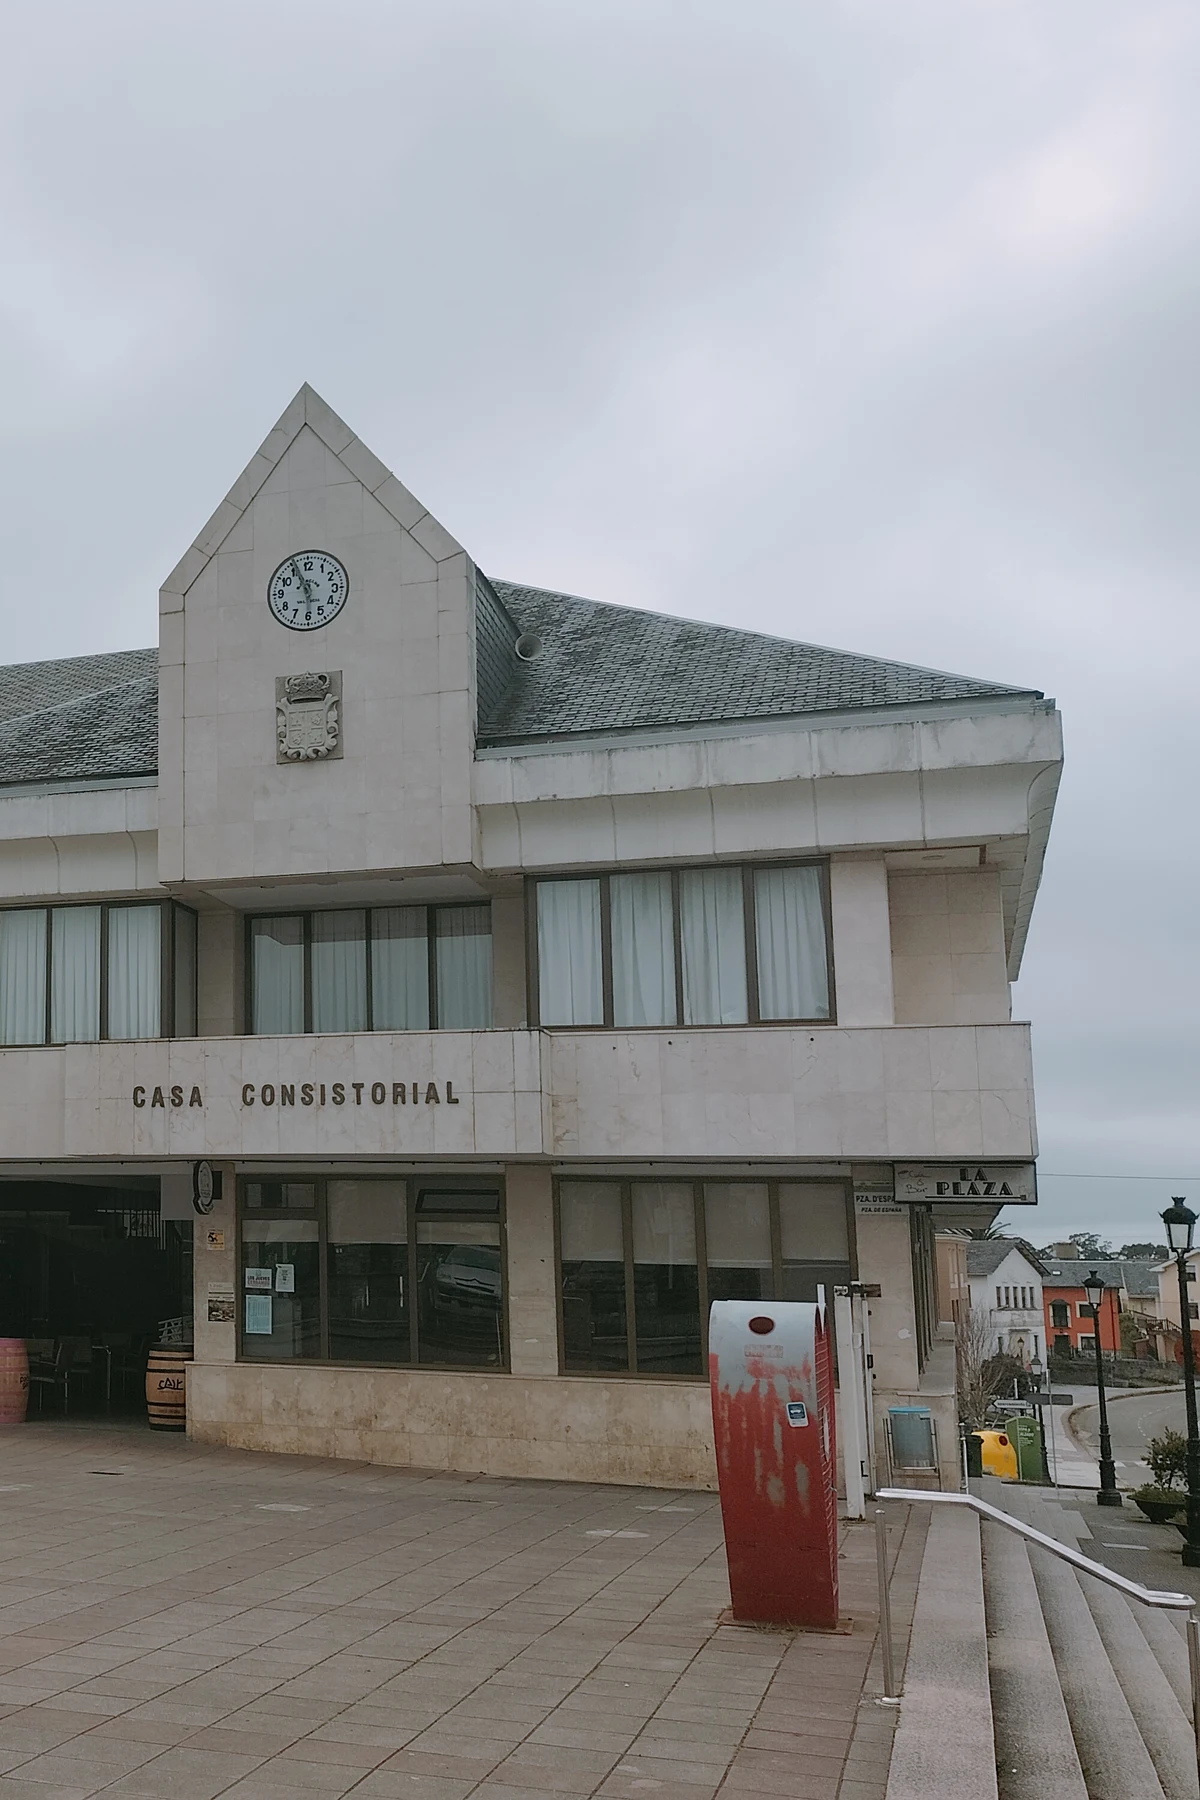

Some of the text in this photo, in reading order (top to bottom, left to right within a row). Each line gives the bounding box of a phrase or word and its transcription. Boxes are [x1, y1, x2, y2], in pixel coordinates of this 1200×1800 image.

[303, 561, 314, 571] 12
[327, 571, 334, 581] 2
[282, 577, 292, 587] 10
[331, 583, 338, 593] 3
[278, 589, 284, 599] 9
[327, 595, 334, 604] 4
[282, 601, 289, 611] 8
[317, 605, 325, 615] 5
[292, 608, 298, 619] 7
[305, 611, 312, 621] 6
[132, 1081, 460, 1108] CASA CONSISTORIAL
[960, 1167, 988, 1181] LA
[936, 1182, 1013, 1195] PLAZA
